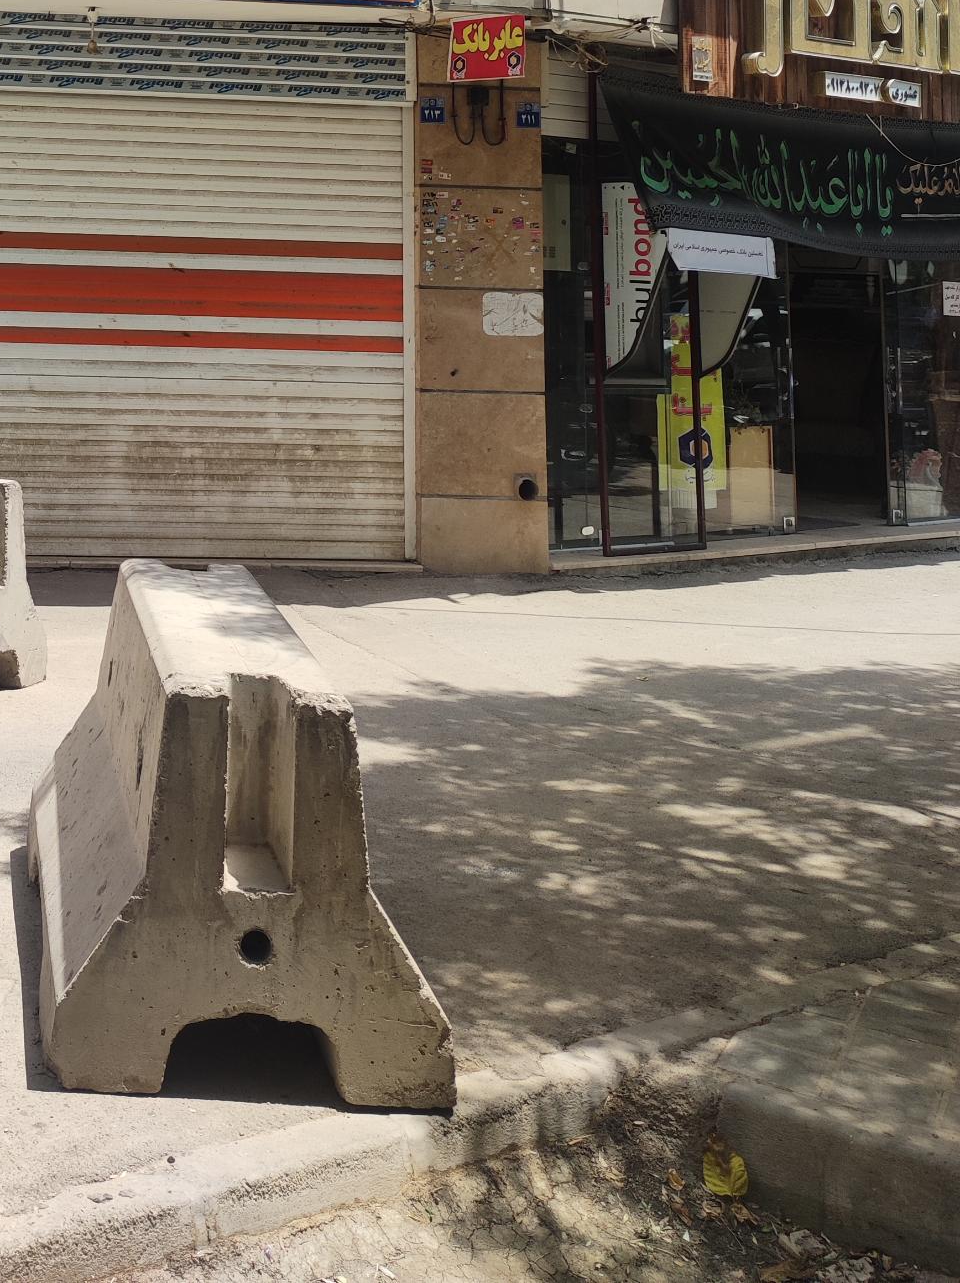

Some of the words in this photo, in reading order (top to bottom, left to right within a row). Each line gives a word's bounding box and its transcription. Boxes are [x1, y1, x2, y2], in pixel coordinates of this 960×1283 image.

[452, 20, 490, 60] بانک
[487, 18, 524, 61] عابر
[424, 109, 441, 120] ۲۱۳
[521, 114, 536, 125] ۲۱۱
